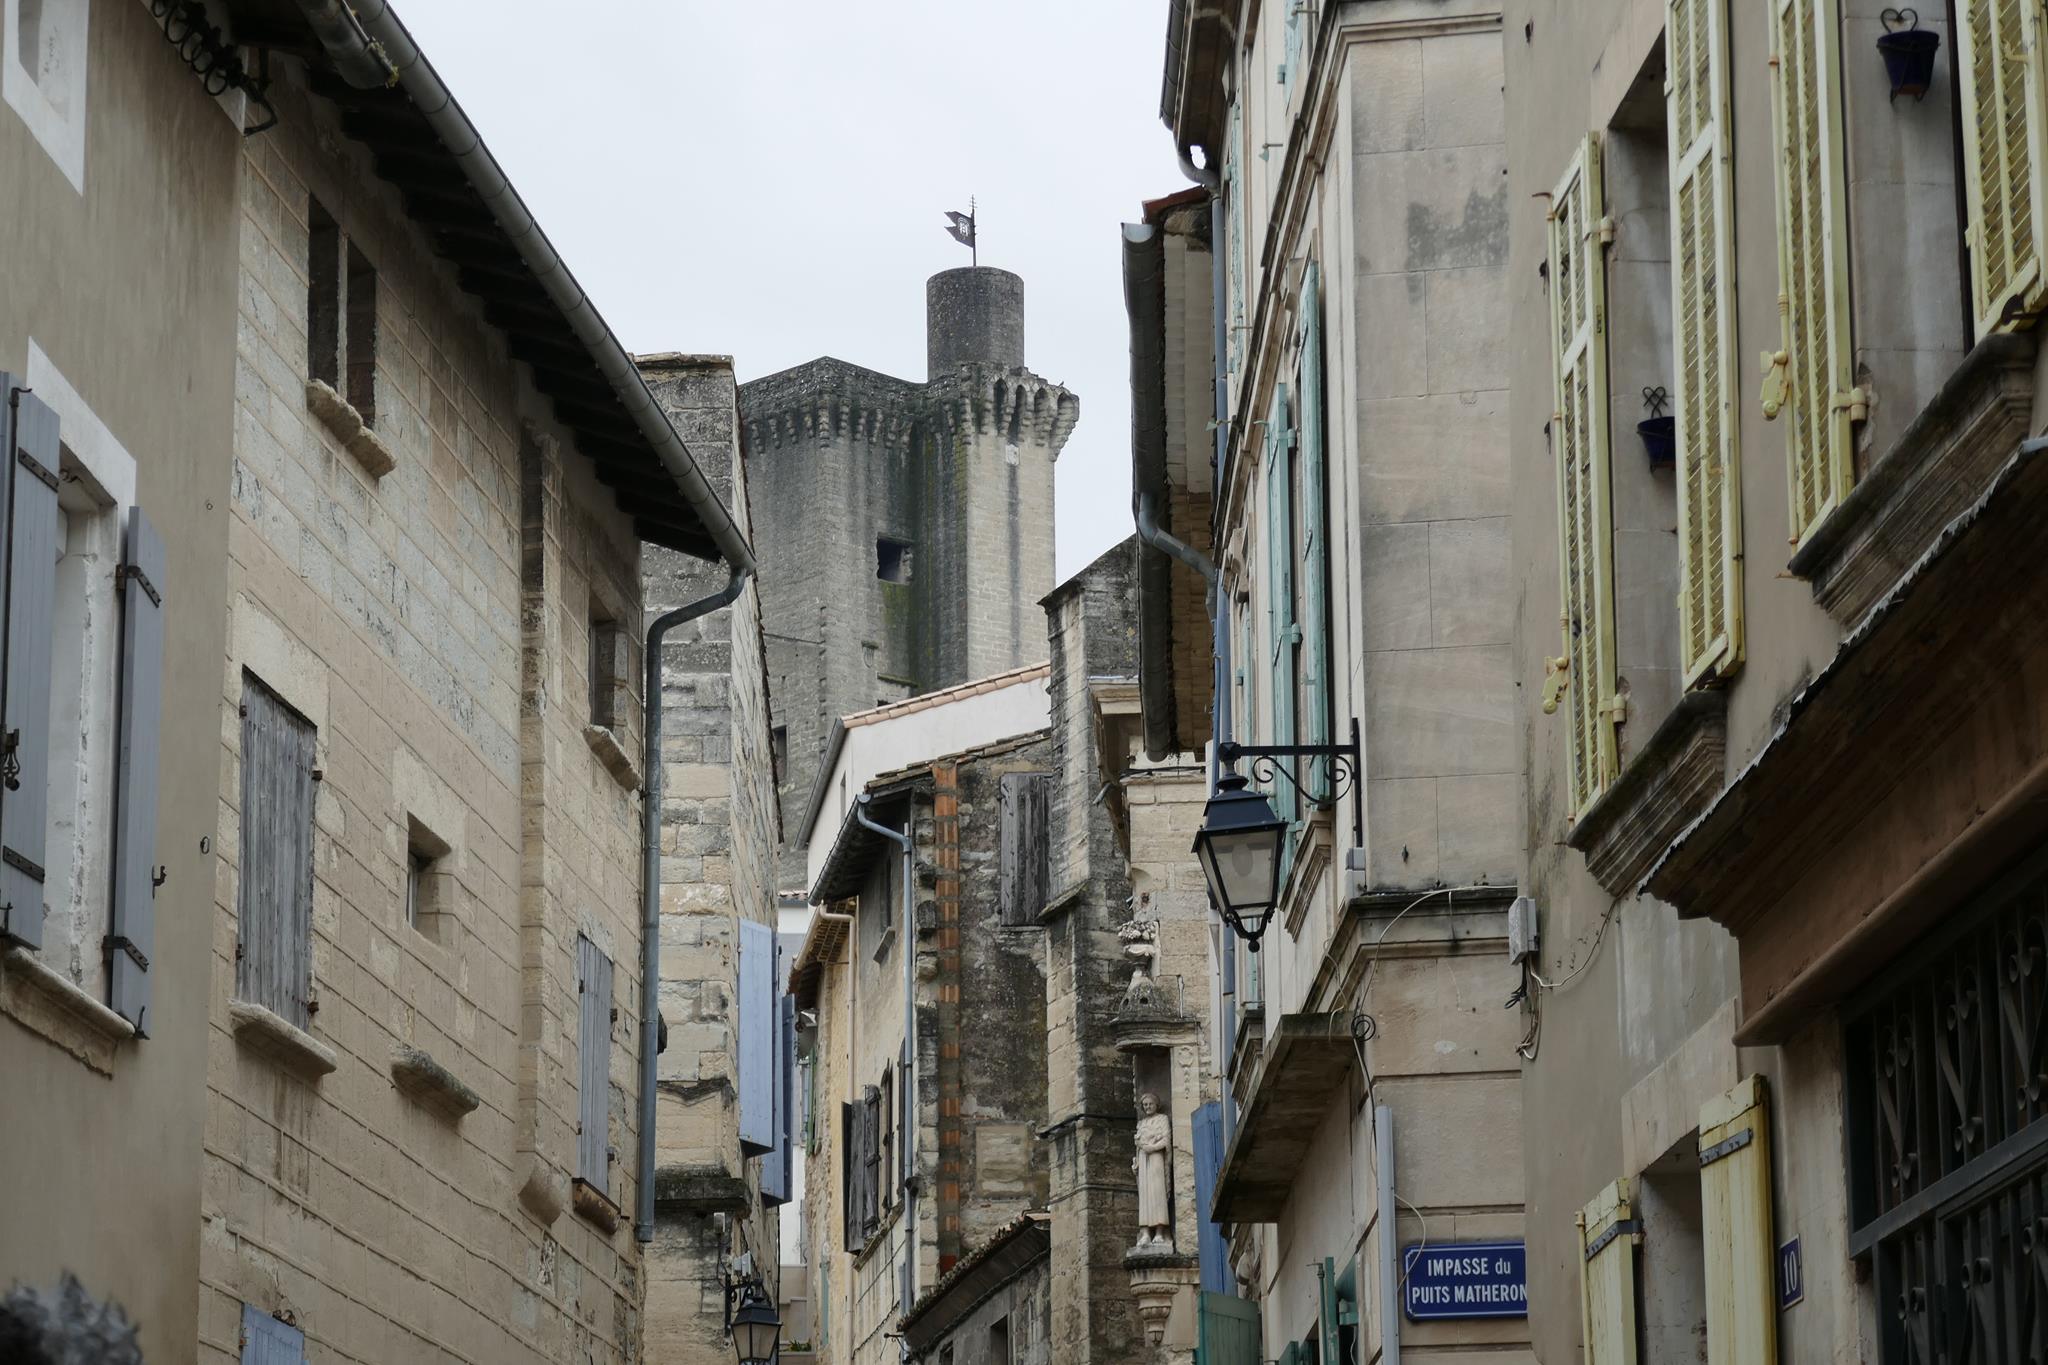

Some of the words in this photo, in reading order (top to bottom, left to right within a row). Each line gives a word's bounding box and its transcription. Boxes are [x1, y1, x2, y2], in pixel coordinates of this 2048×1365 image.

[1428, 1258, 1488, 1276] IMPASSE
[1495, 1258, 1511, 1274] du
[1784, 1251, 1797, 1296] 10
[1412, 1286, 1450, 1304] PUITS
[1454, 1284, 1528, 1302] MATHERON
